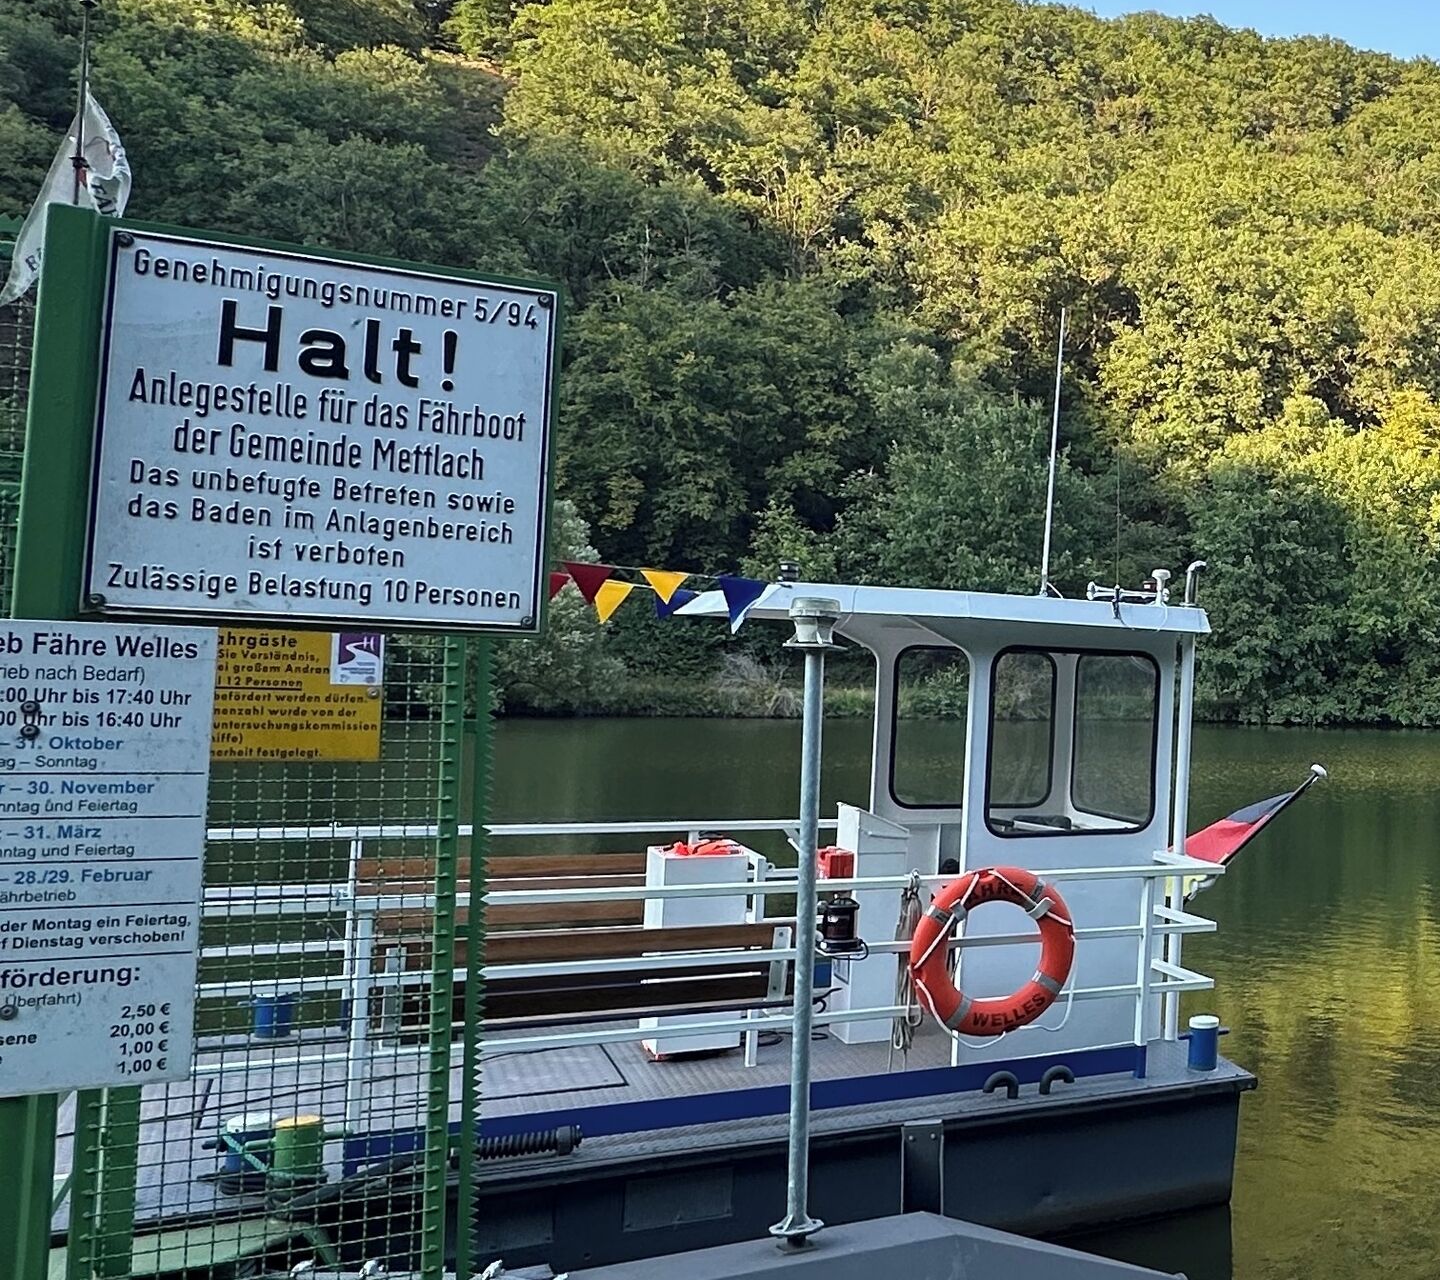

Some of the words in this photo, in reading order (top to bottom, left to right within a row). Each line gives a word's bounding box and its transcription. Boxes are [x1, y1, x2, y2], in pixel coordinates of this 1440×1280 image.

[134, 250, 467, 319] Genehmigungsnummer
[474, 299, 539, 329] 5/94
[217, 299, 458, 392] Halt!
[129, 369, 307, 419] Anlegestelle
[319, 390, 353, 423] für
[364, 395, 408, 429] das
[418, 399, 526, 441] Fährboot
[174, 419, 222, 454] der
[229, 425, 361, 466] Gemeinde
[374, 440, 485, 480] Mettlach
[130, 460, 179, 486] Das
[192, 466, 320, 501] unbefugte
[334, 479, 435, 508] Betreten
[447, 490, 515, 514] sowie
[127, 495, 177, 518] das
[192, 499, 272, 527] Baden
[285, 506, 314, 529] im
[326, 510, 512, 544] Anlagenbereich
[248, 536, 281, 560] ist
[296, 540, 405, 567] verboten
[108, 564, 238, 597] Zulässige
[249, 574, 372, 604] Belastung
[384, 581, 408, 601] 10
[415, 585, 521, 610] Personen
[33, 633, 106, 656] Fähre
[116, 636, 198, 658] Welles
[241, 650, 320, 662] Verständnis,
[36, 665, 76, 680] nach
[84, 666, 145, 685] Bedarf)
[245, 677, 302, 686] Personen
[34, 688, 67, 703] Uhr
[73, 689, 99, 703] bis
[107, 690, 153, 704] 17:40
[160, 690, 191, 705] Uhr
[275, 694, 320, 702] werden
[24, 711, 56, 726] Uhr
[63, 712, 89, 726] bis
[97, 712, 144, 727] 16:40
[151, 713, 181, 728] Uhr
[269, 707, 307, 716] wurde
[338, 707, 357, 717] der
[16, 736, 42, 749] 31.
[50, 737, 123, 749] Oktober
[35, 756, 97, 769] Sonntag
[28, 781, 54, 794] 30.
[61, 781, 155, 794] November
[45, 800, 72, 812] und
[78, 800, 138, 813] Feiertag
[24, 826, 50, 839] 31.
[58, 825, 101, 838] März
[42, 845, 69, 856] und
[75, 845, 134, 857] Feiertag
[14, 870, 74, 884] 28./29.
[81, 870, 152, 882] Februar
[1, 920, 27, 932] der
[32, 919, 91, 933] Montag
[97, 916, 120, 928] ein
[125, 915, 191, 927] Feiertag,
[13, 935, 83, 948] Dienstag
[89, 931, 185, 945] verschoben!
[1, 967, 141, 988] förderung:
[6, 992, 82, 1007] Überfahrt)
[122, 1004, 156, 1019] 2,50
[160, 1003, 171, 1015] €
[973, 993, 1046, 1027] WELLES
[110, 1023, 154, 1038] 20,00
[159, 1021, 169, 1033] €
[120, 1041, 153, 1056] 1,00
[158, 1040, 168, 1051] €
[117, 1060, 151, 1075] 1,00
[157, 1058, 166, 1070] €
